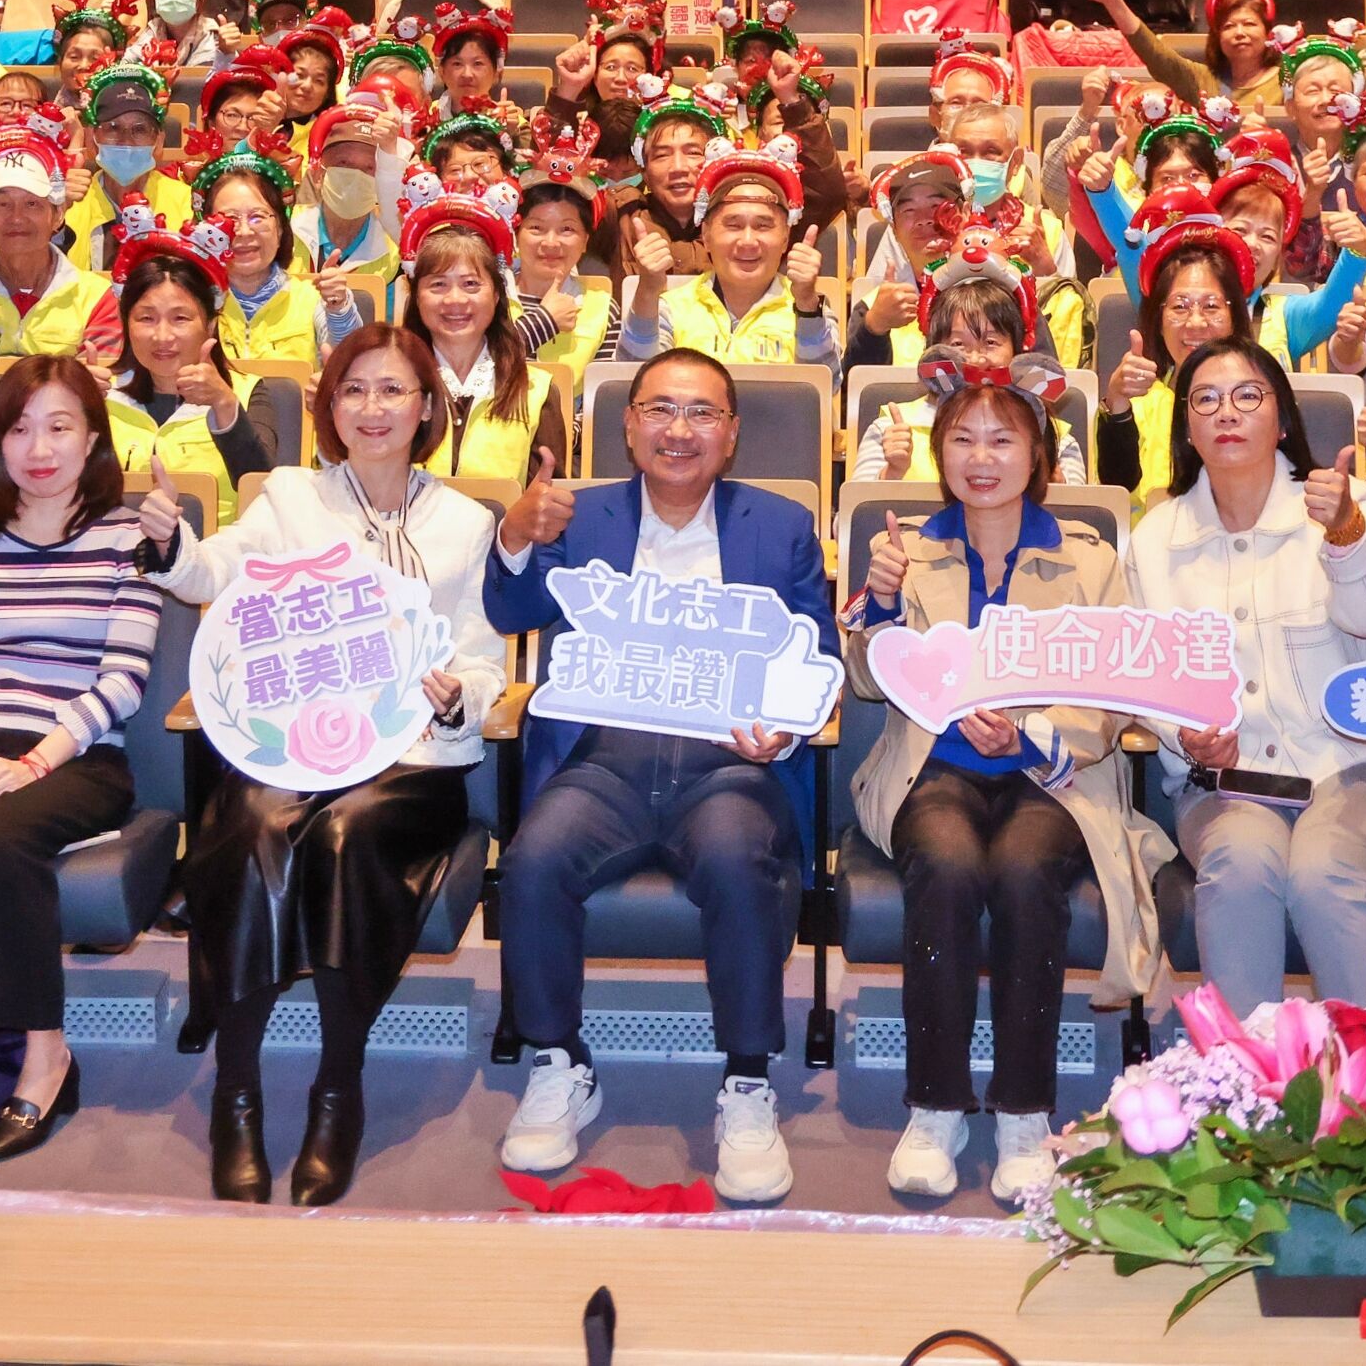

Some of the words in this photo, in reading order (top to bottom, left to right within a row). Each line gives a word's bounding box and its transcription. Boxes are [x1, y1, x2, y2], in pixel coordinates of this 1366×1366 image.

[230, 573, 385, 646] 當志工
[573, 566, 770, 638] 文化志工
[244, 629, 397, 706] 最美麗
[554, 634, 729, 714] 我最讚
[979, 609, 1233, 682] 使命必達
